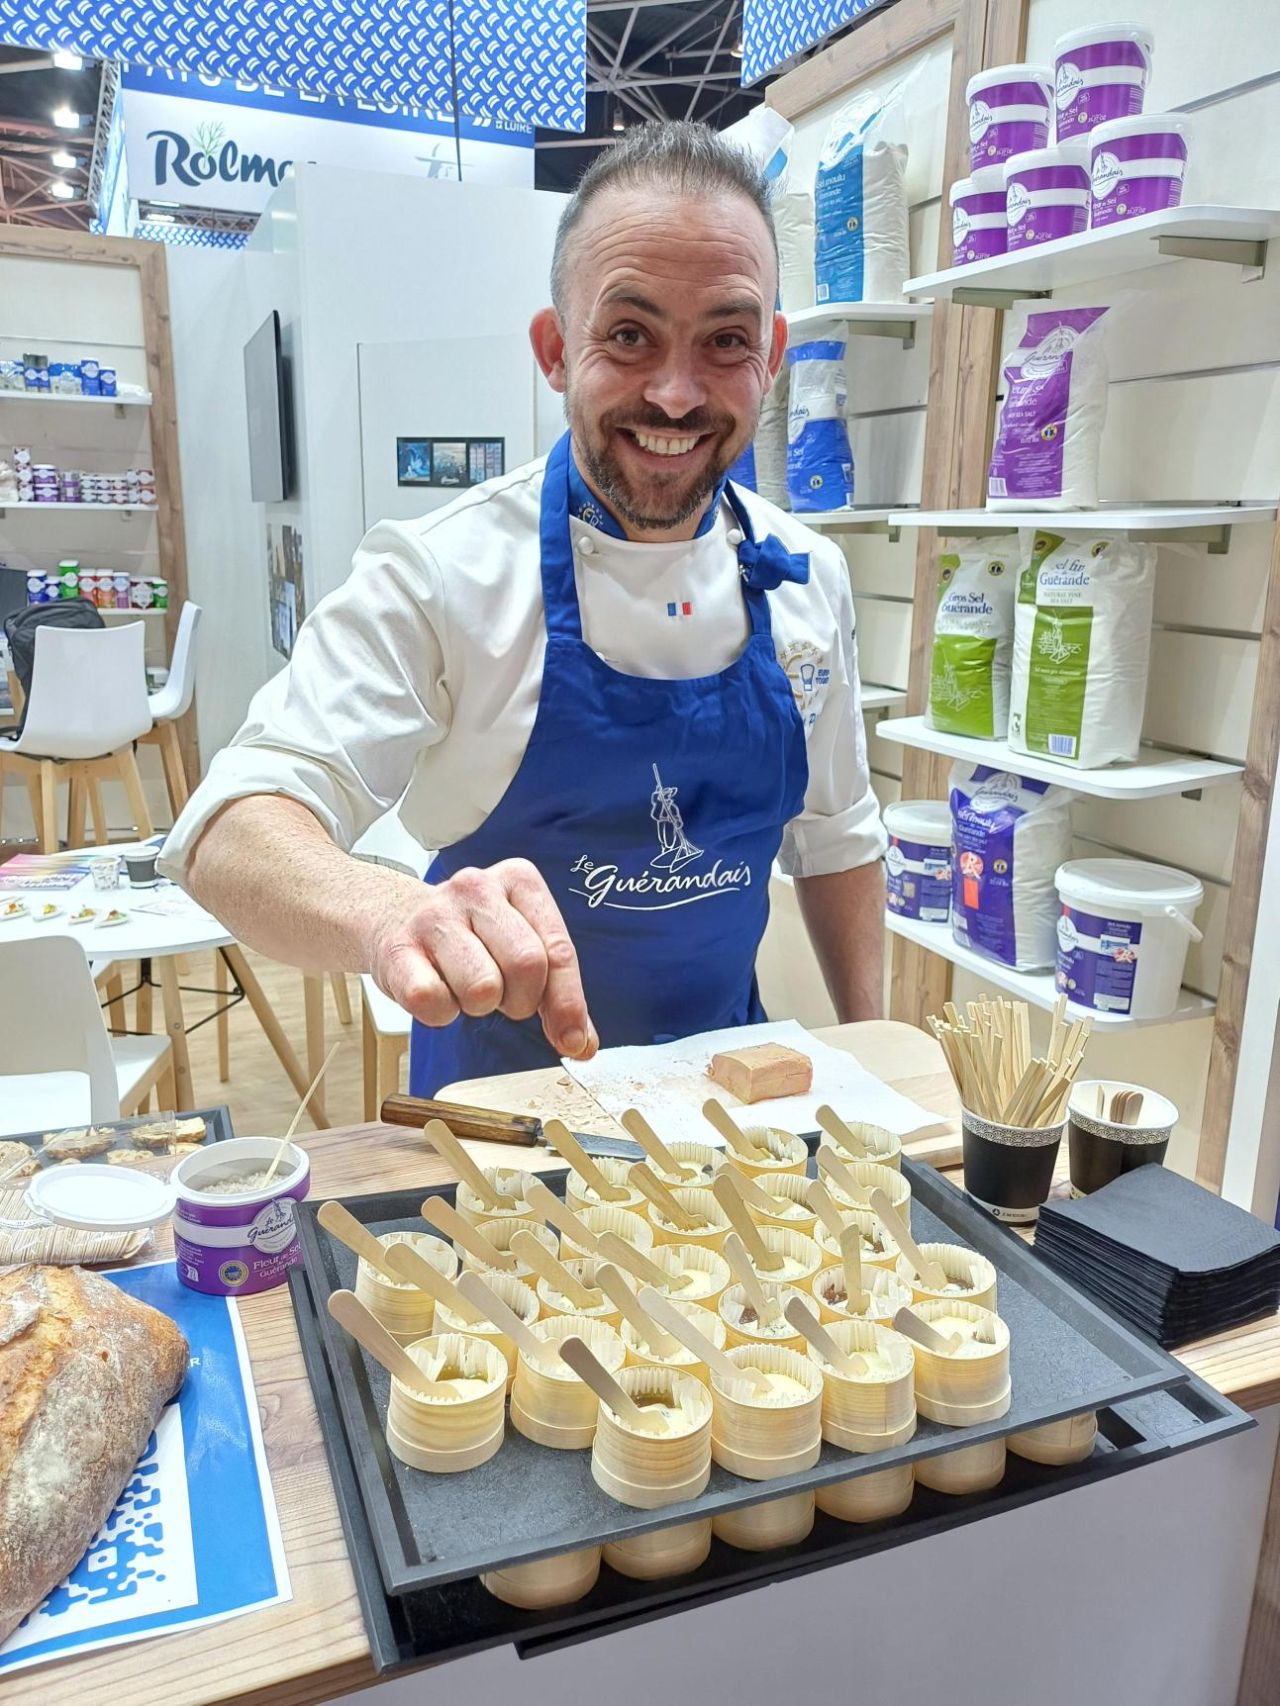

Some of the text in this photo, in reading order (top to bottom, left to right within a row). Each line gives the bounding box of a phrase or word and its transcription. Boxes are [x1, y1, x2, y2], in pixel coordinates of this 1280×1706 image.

[146, 129, 317, 188] Rolm
[968, 591, 984, 603] Sel
[570, 854, 595, 874] Le
[584, 858, 752, 909] Guérandais
[247, 1213, 294, 1244] Guérand
[253, 1255, 280, 1270] Fleur
[289, 1240, 301, 1256] Sel
